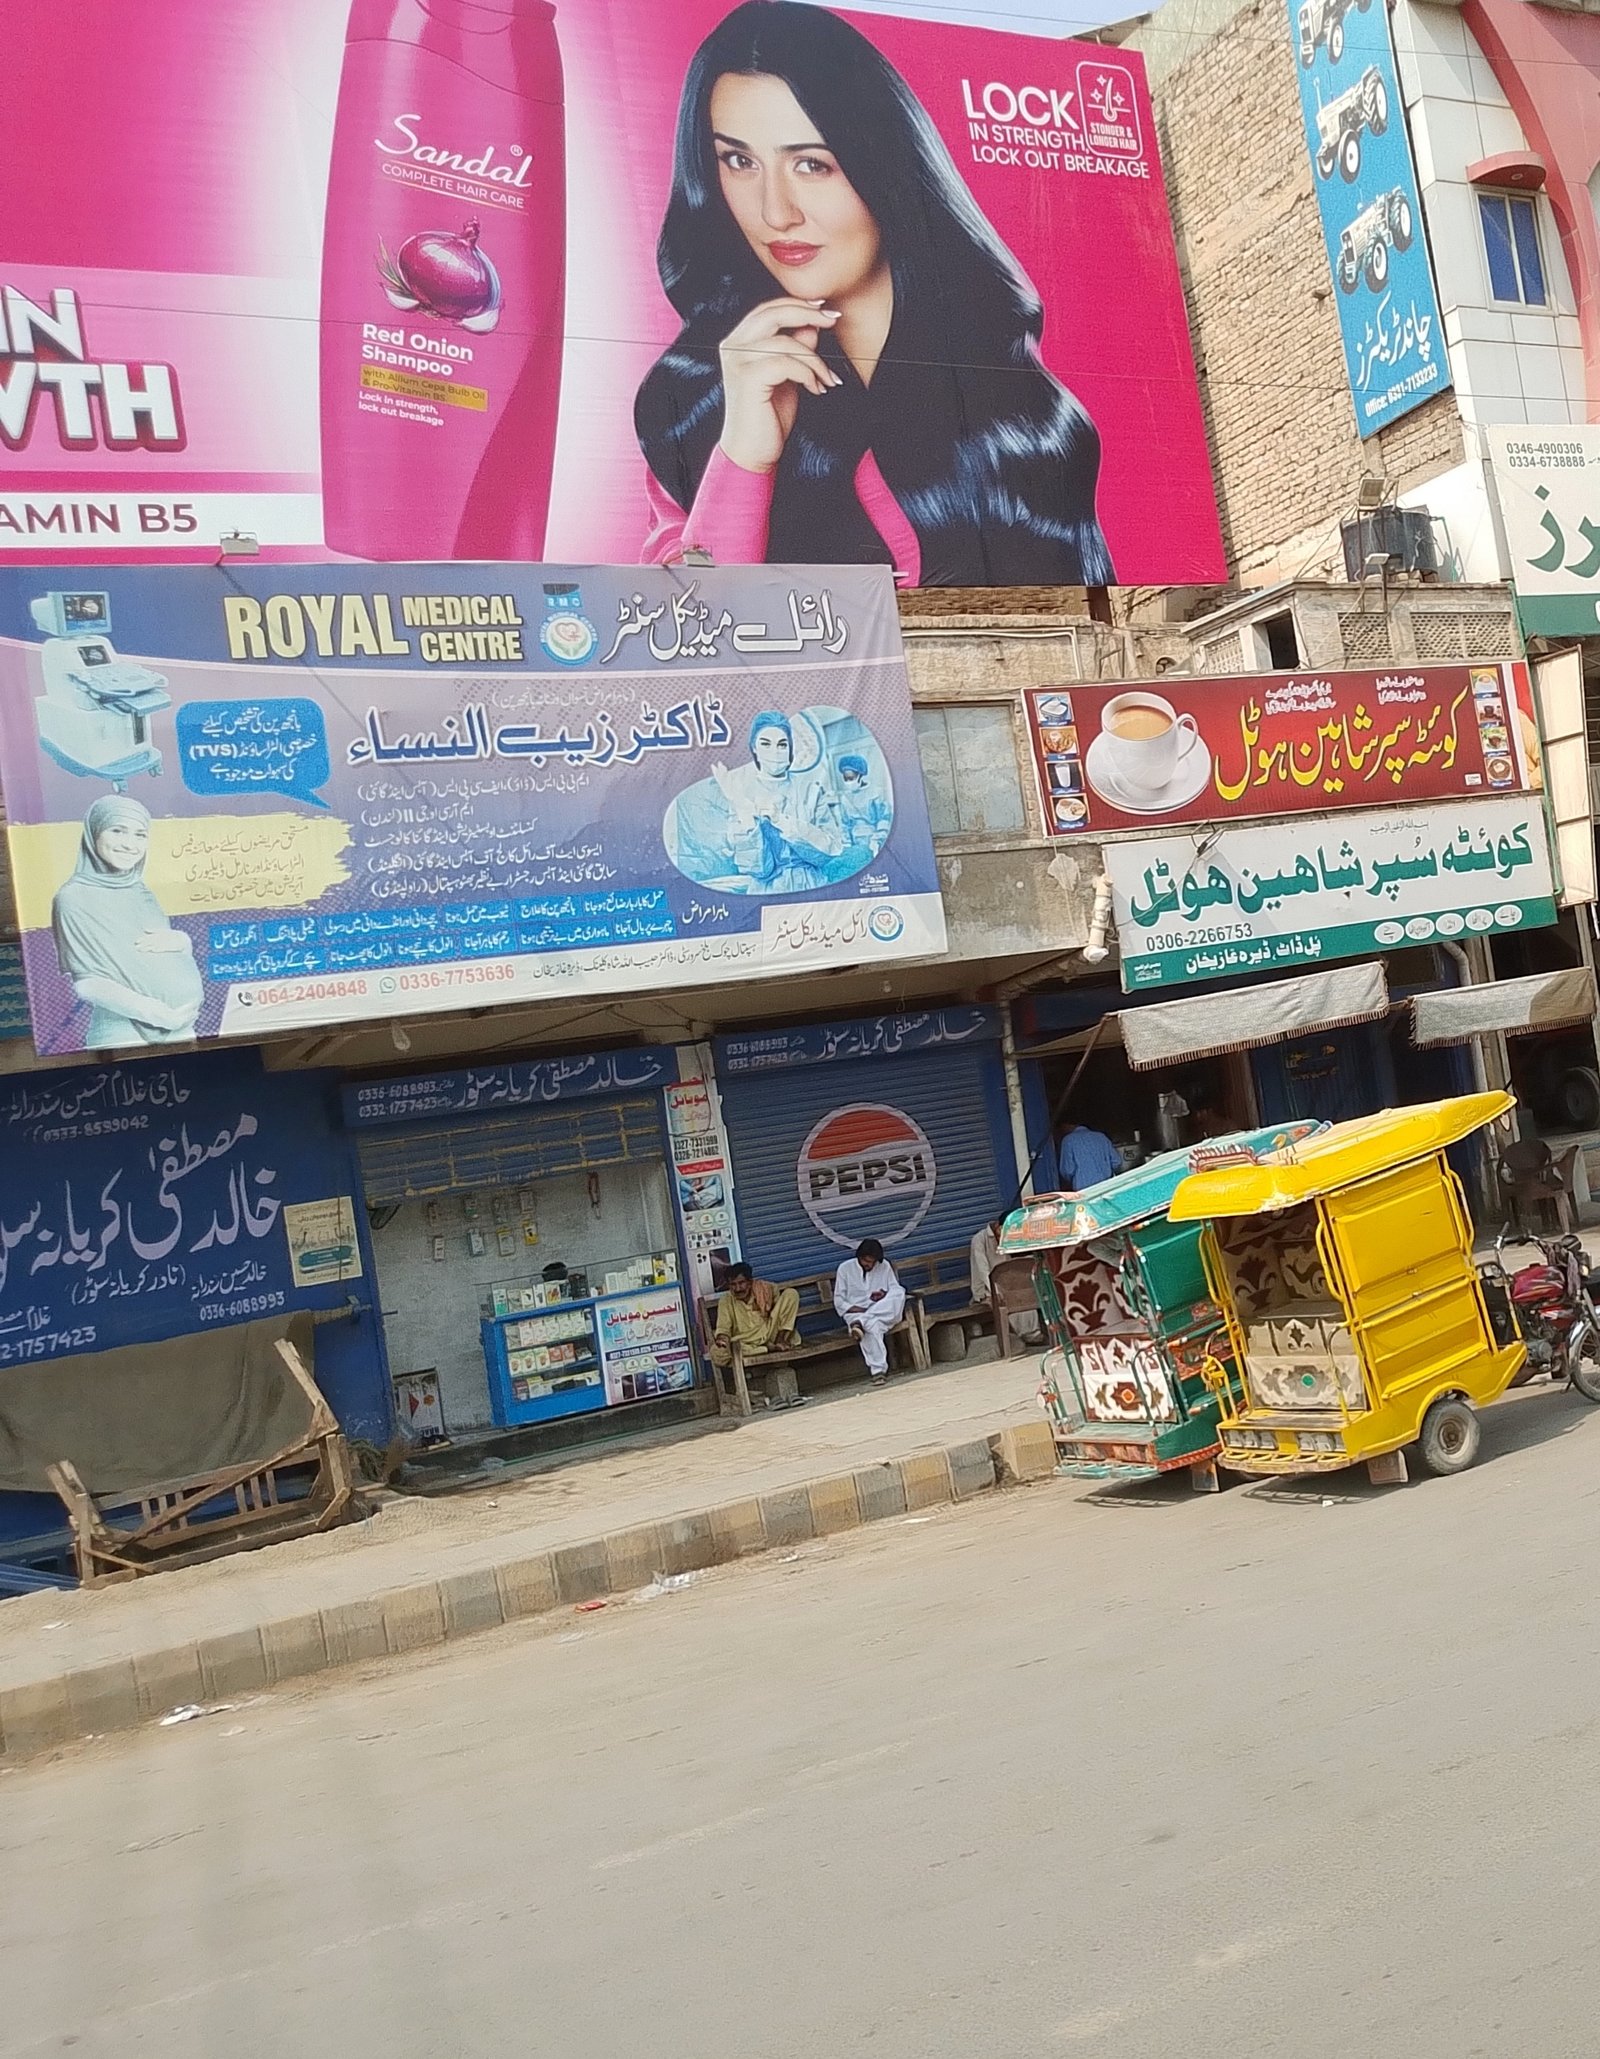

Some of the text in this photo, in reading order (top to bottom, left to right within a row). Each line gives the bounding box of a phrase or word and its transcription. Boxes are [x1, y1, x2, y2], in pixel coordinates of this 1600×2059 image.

[961, 79, 1080, 130] LOCK
[374, 114, 533, 188] Sandal
[969, 122, 1090, 154] IN STRENGTH,
[972, 145, 1151, 179] LOCK OUT BREAKAGE
[382, 163, 525, 209] COMPLETE HAIR CARE
[363, 323, 473, 361] Red Onion
[362, 344, 453, 376] Shampoo
[358, 401, 444, 426] lock out breakage
[360, 391, 438, 415] Lock in strength,
[1506, 442, 1584, 455] 0346-4900306
[1509, 456, 1586, 468] 0334-6738888
[137, 504, 198, 534] B5
[223, 594, 410, 660] ROYAL
[402, 595, 523, 627] MEDICAL
[420, 630, 524, 662] CENTRE
[347, 689, 732, 769] ڈاکٹر زیب النساء
[1213, 697, 1288, 801] ہوٹل
[1146, 922, 1253, 951] 0306-2266753
[257, 980, 368, 1005] 064-2404848
[399, 964, 515, 991] 0336-7753636
[809, 1152, 926, 1200] PEPSI
[189, 1161, 281, 1253] خالد
[200, 1291, 285, 1321] 0336-6088993
